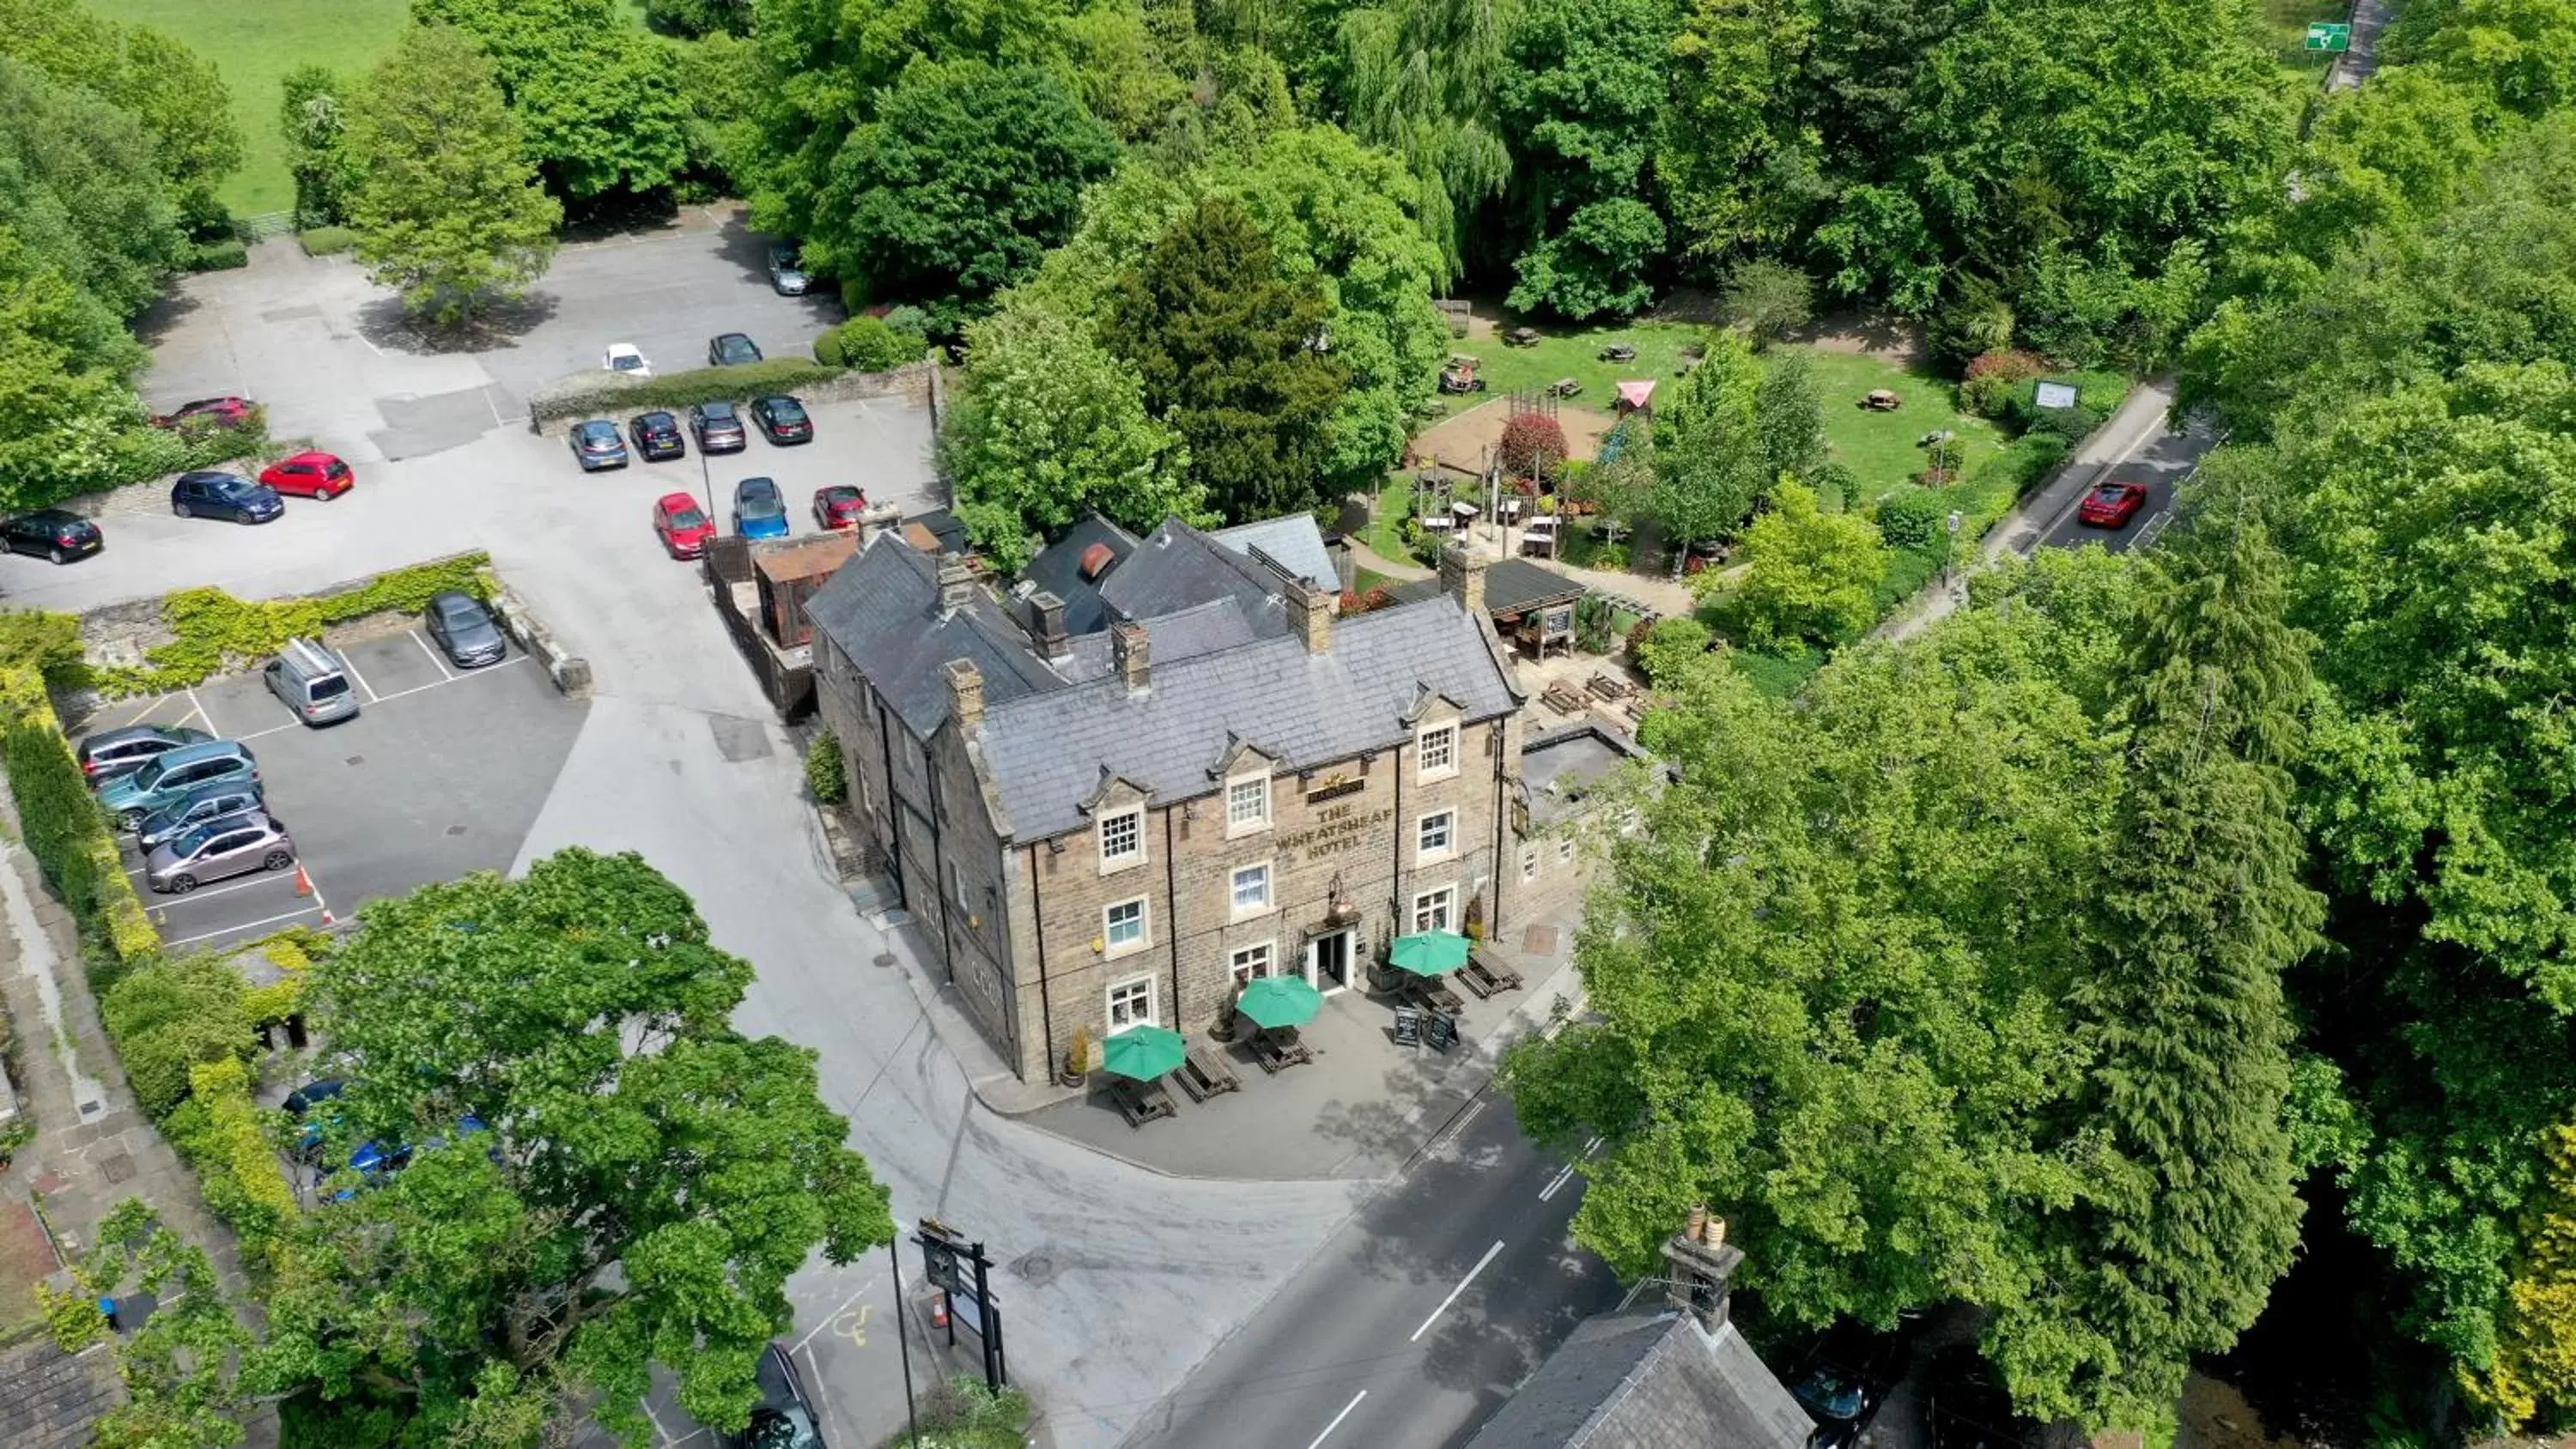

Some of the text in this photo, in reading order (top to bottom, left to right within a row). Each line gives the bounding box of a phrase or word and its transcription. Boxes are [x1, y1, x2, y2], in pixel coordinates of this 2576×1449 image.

[1317, 803, 1352, 823] THE
[1275, 809, 1393, 852] WHEATSHEAF
[1306, 836, 1361, 860] HOTEL
